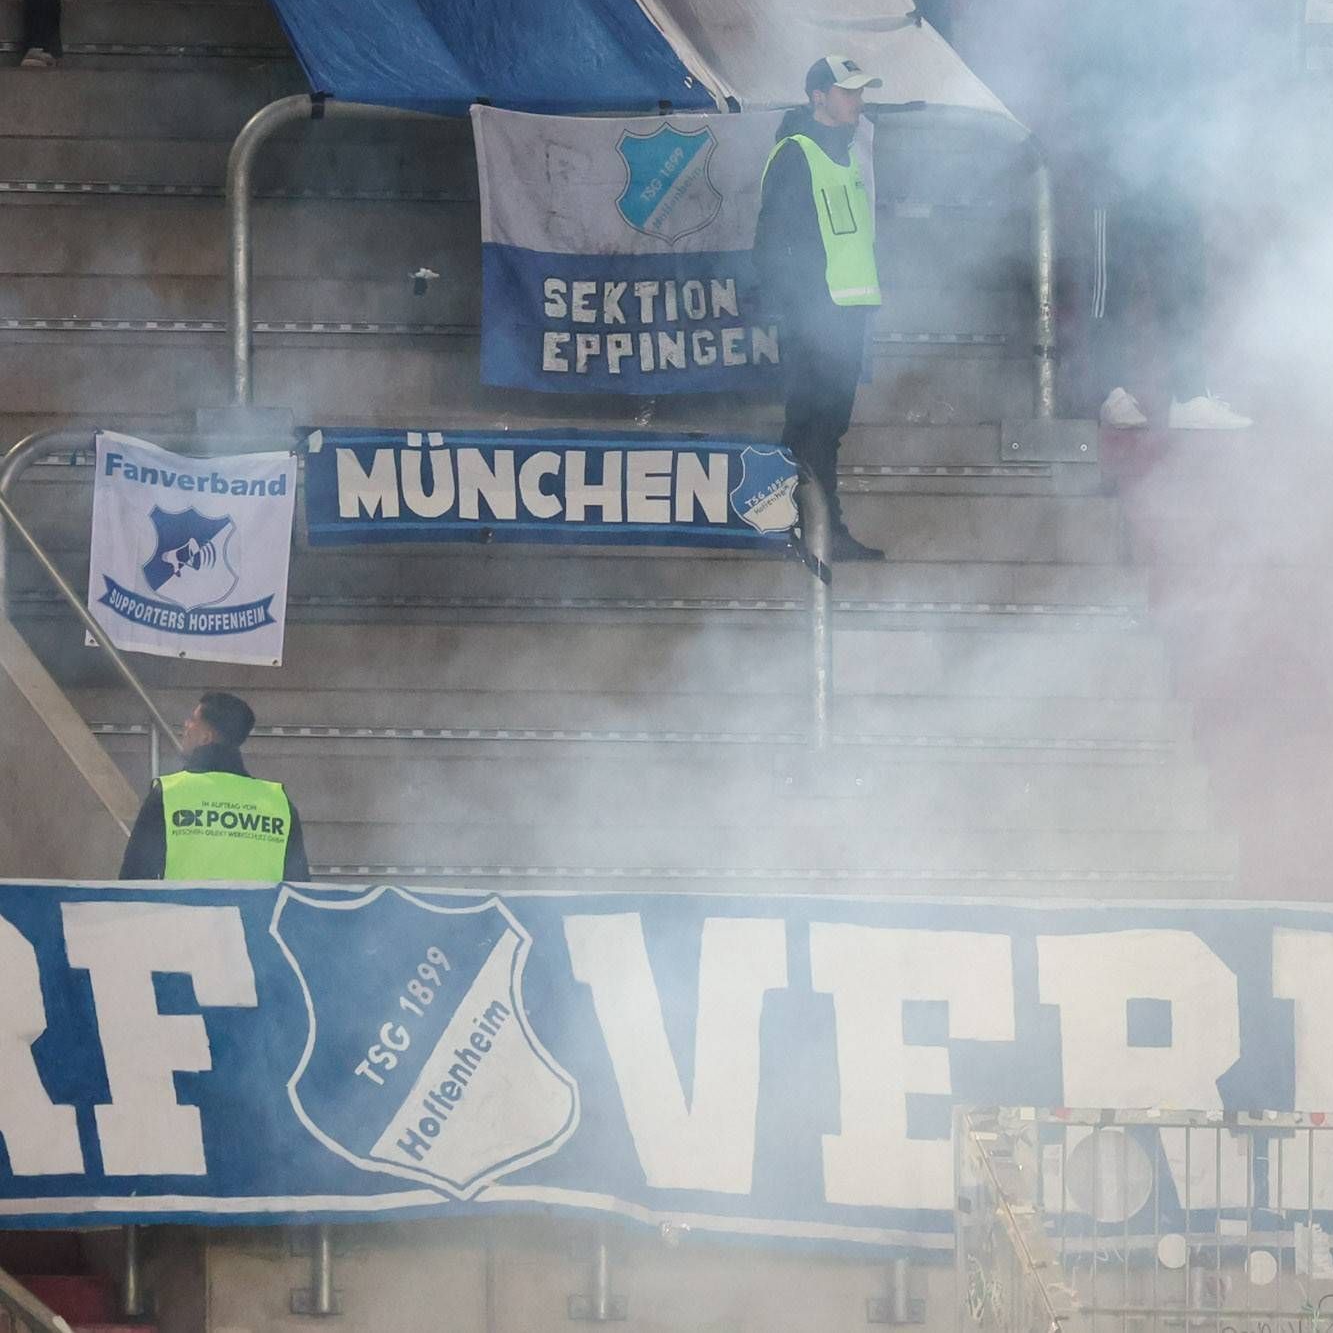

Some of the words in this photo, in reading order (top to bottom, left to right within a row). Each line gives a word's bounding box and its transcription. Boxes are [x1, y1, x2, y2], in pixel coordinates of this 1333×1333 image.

[543, 277, 740, 325] SEKTION
[541, 325, 781, 375] EPPINGEN
[104, 451, 288, 498] Fanverband
[335, 432, 729, 524] MÜNCHEN
[109, 588, 186, 631] SUPPORTERS
[187, 606, 267, 632] HOFFENHEIM
[206, 810, 285, 836] POWER
[354, 1021, 412, 1089] TSG
[398, 945, 455, 1020] 1899
[395, 997, 513, 1164] Hoffenheim
